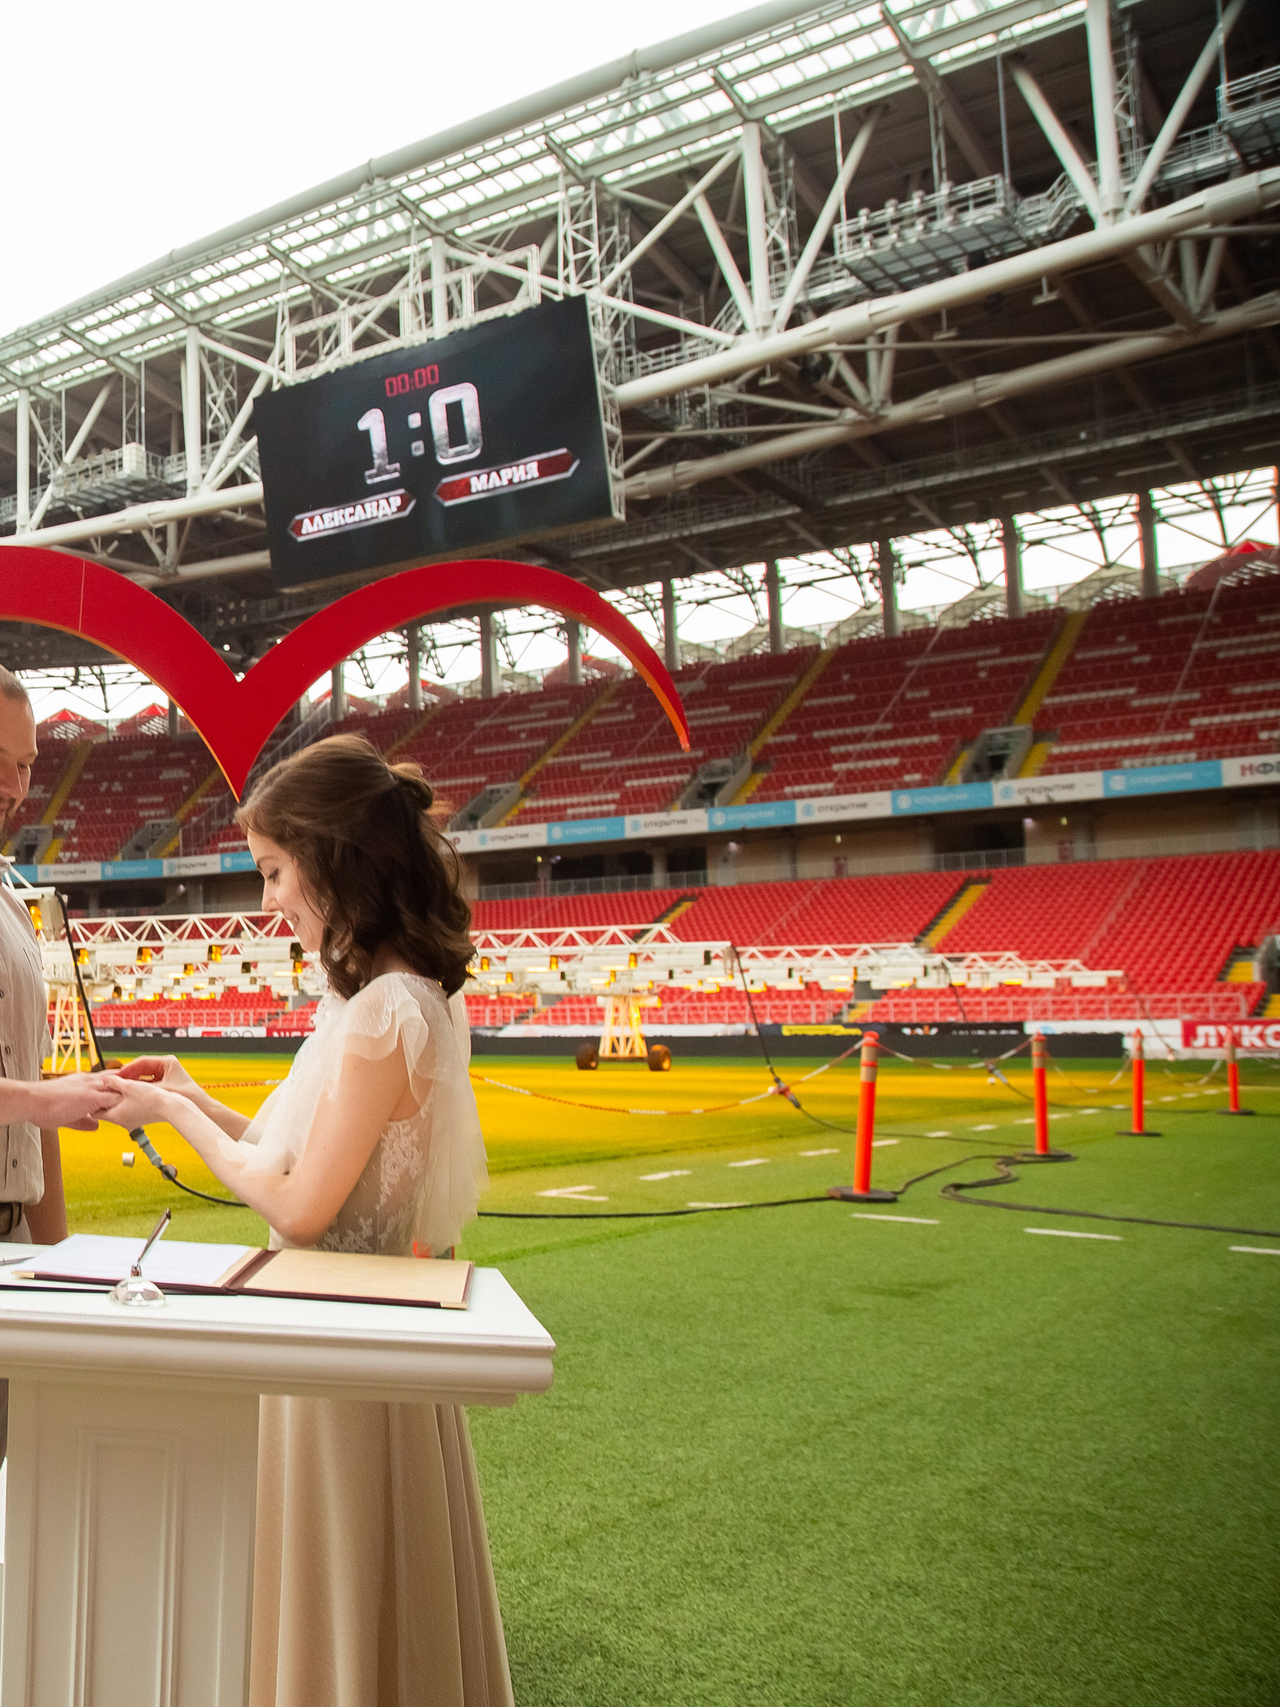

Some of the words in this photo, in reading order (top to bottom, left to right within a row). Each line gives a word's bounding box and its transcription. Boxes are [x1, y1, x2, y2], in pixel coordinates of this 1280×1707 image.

[385, 364, 440, 398] 00:00
[470, 461, 540, 493] МАРИЯ
[301, 495, 402, 535] АЛЕКСАНДР
